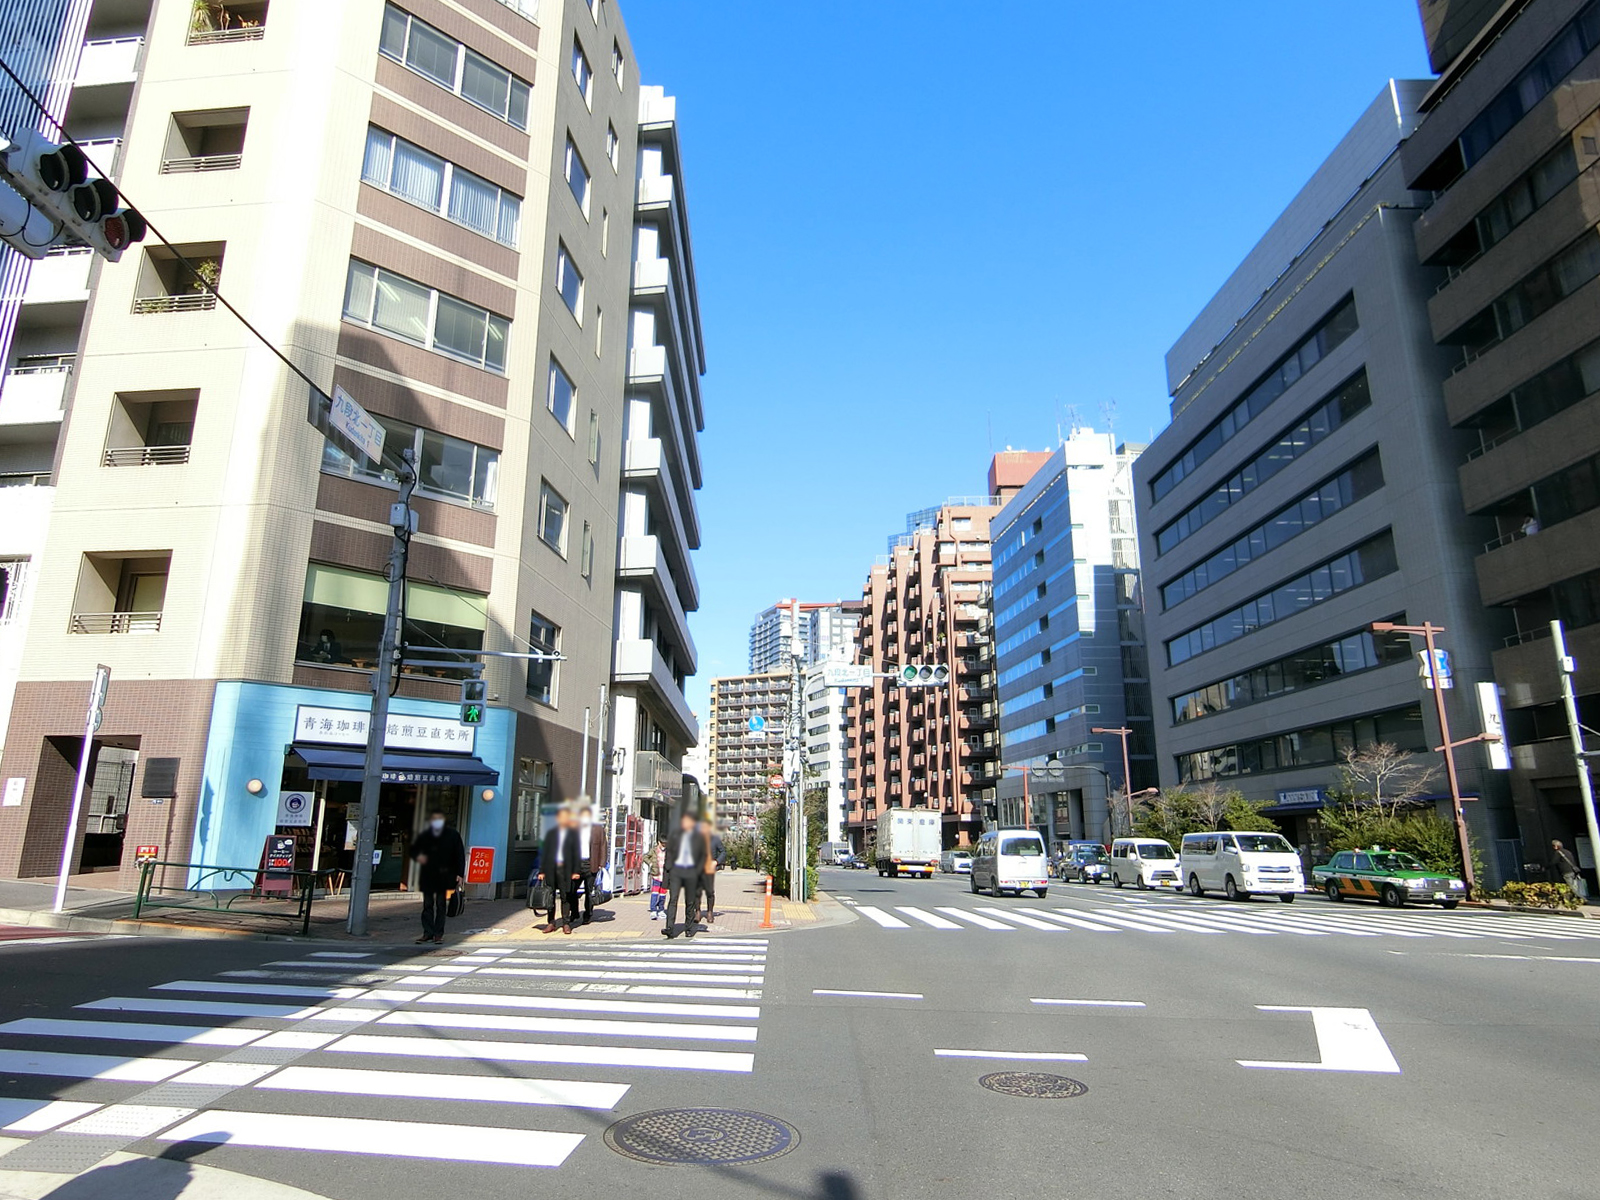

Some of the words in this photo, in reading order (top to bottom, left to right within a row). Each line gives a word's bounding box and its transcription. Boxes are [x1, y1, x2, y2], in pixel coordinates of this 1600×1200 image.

[335, 395, 382, 447] 九段北一丁目
[303, 716, 366, 733] 青海珈琲
[386, 723, 470, 742] 焙煎豆直売所
